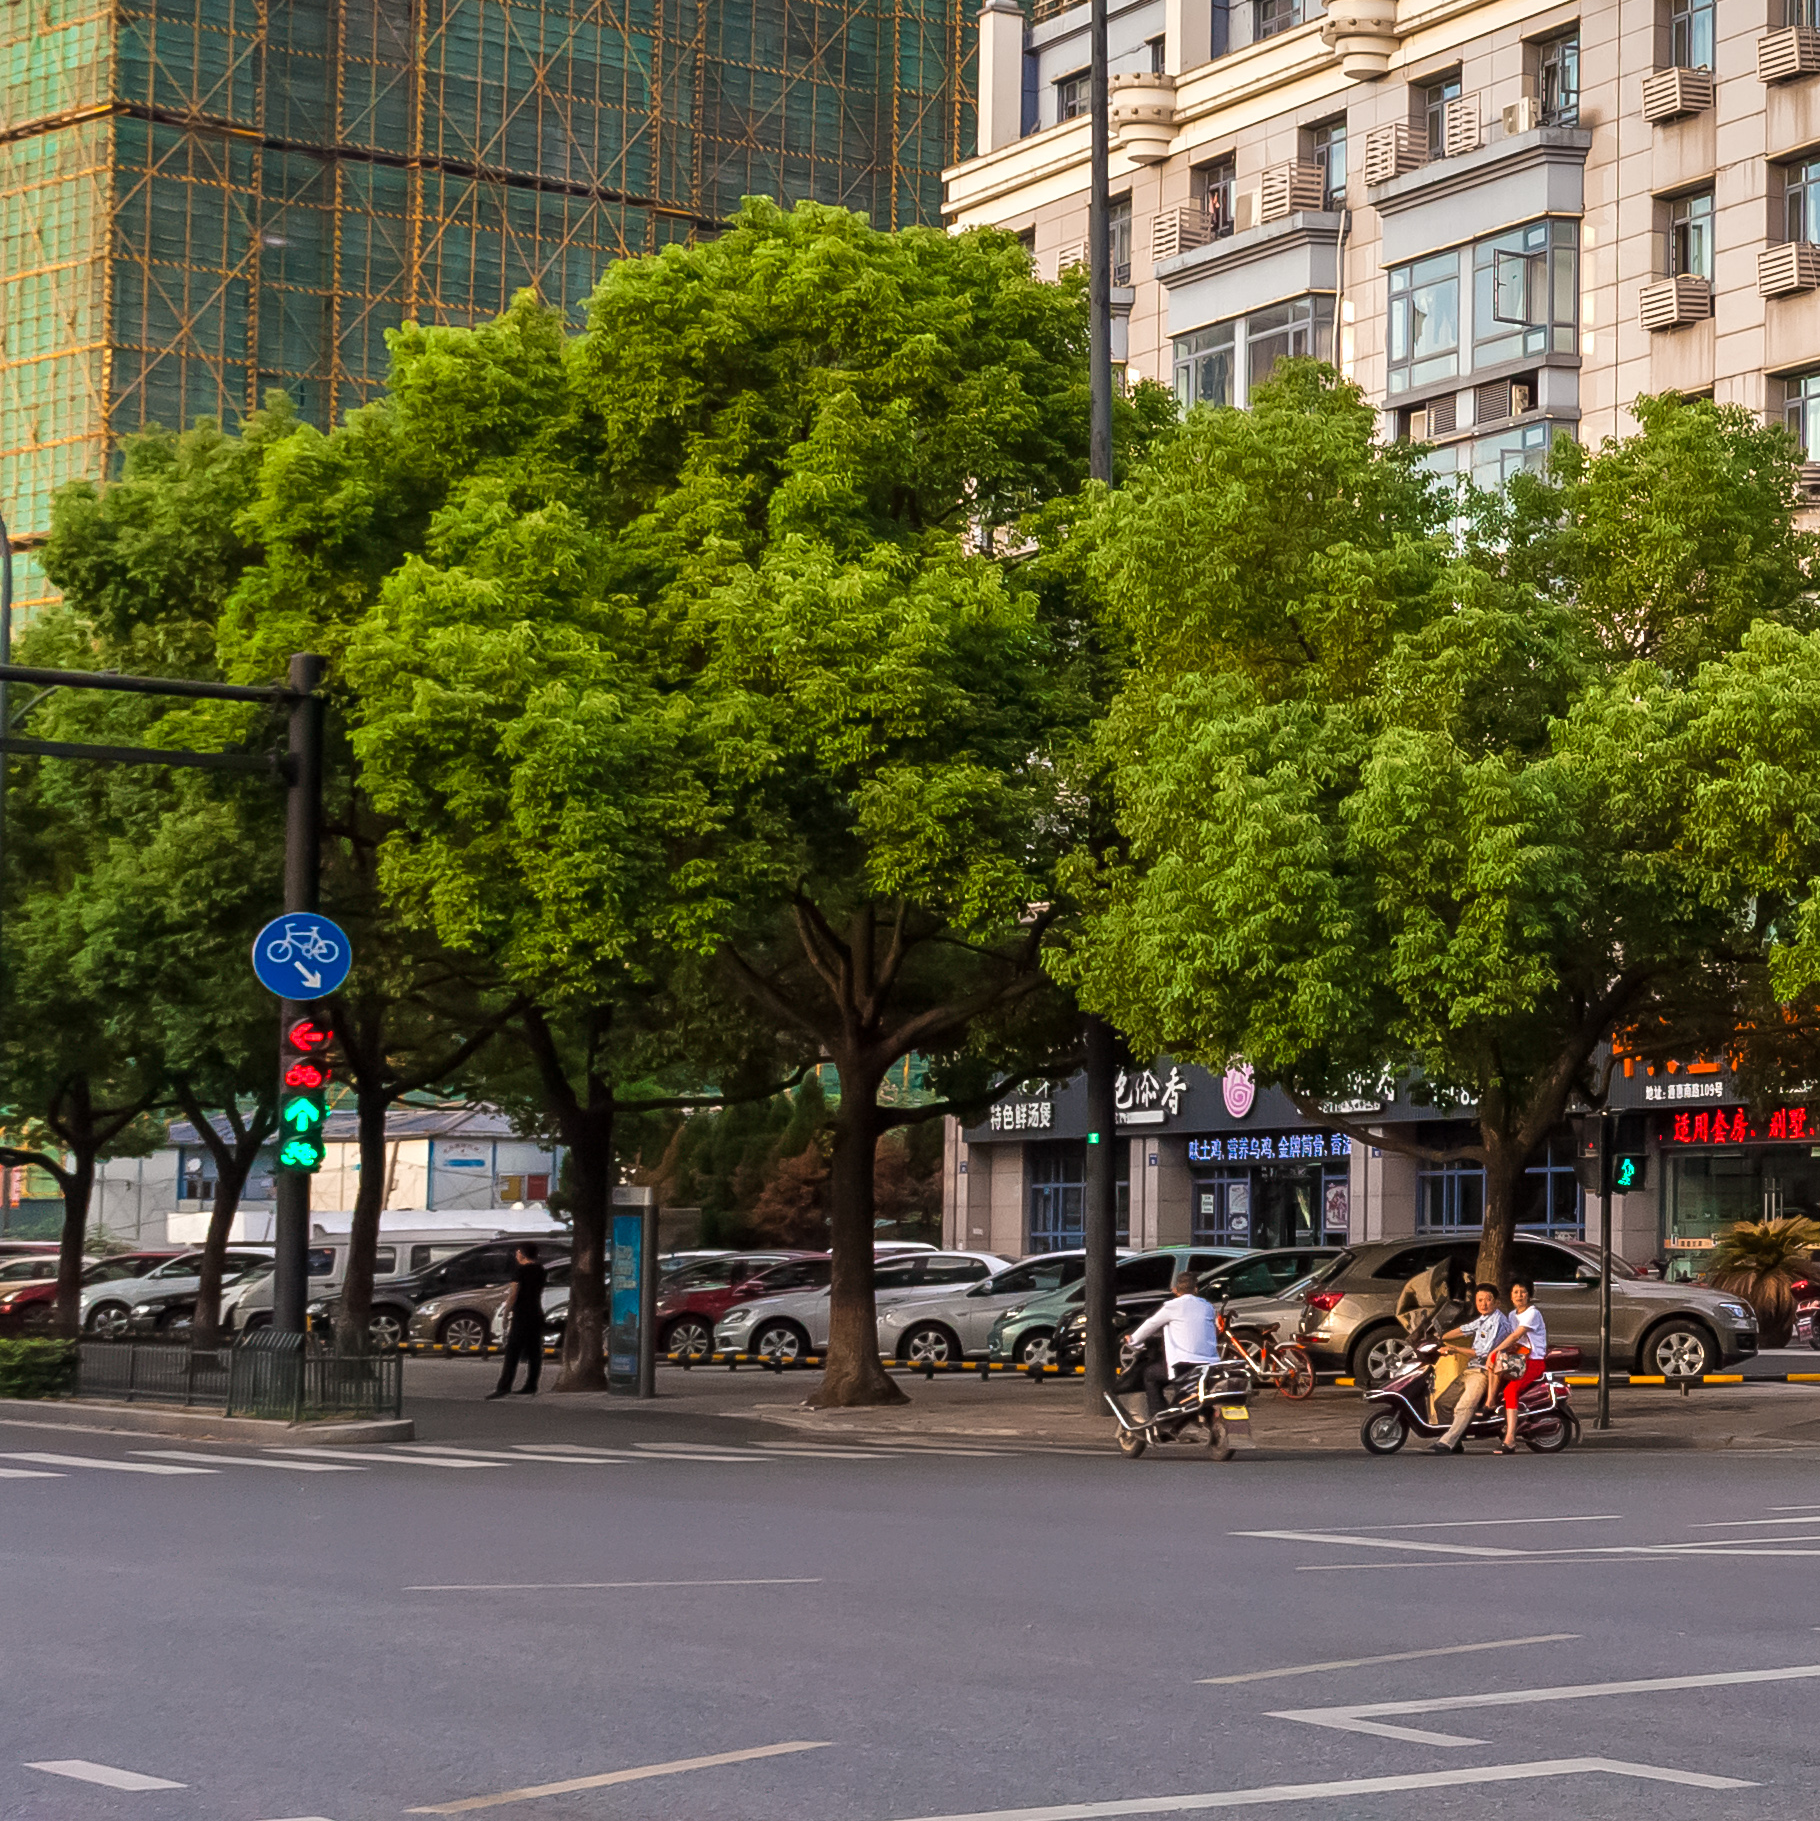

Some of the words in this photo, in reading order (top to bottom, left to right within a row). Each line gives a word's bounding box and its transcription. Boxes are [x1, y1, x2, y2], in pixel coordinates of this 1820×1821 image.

[990, 1102, 1051, 1131] 特色鲜汤煲
